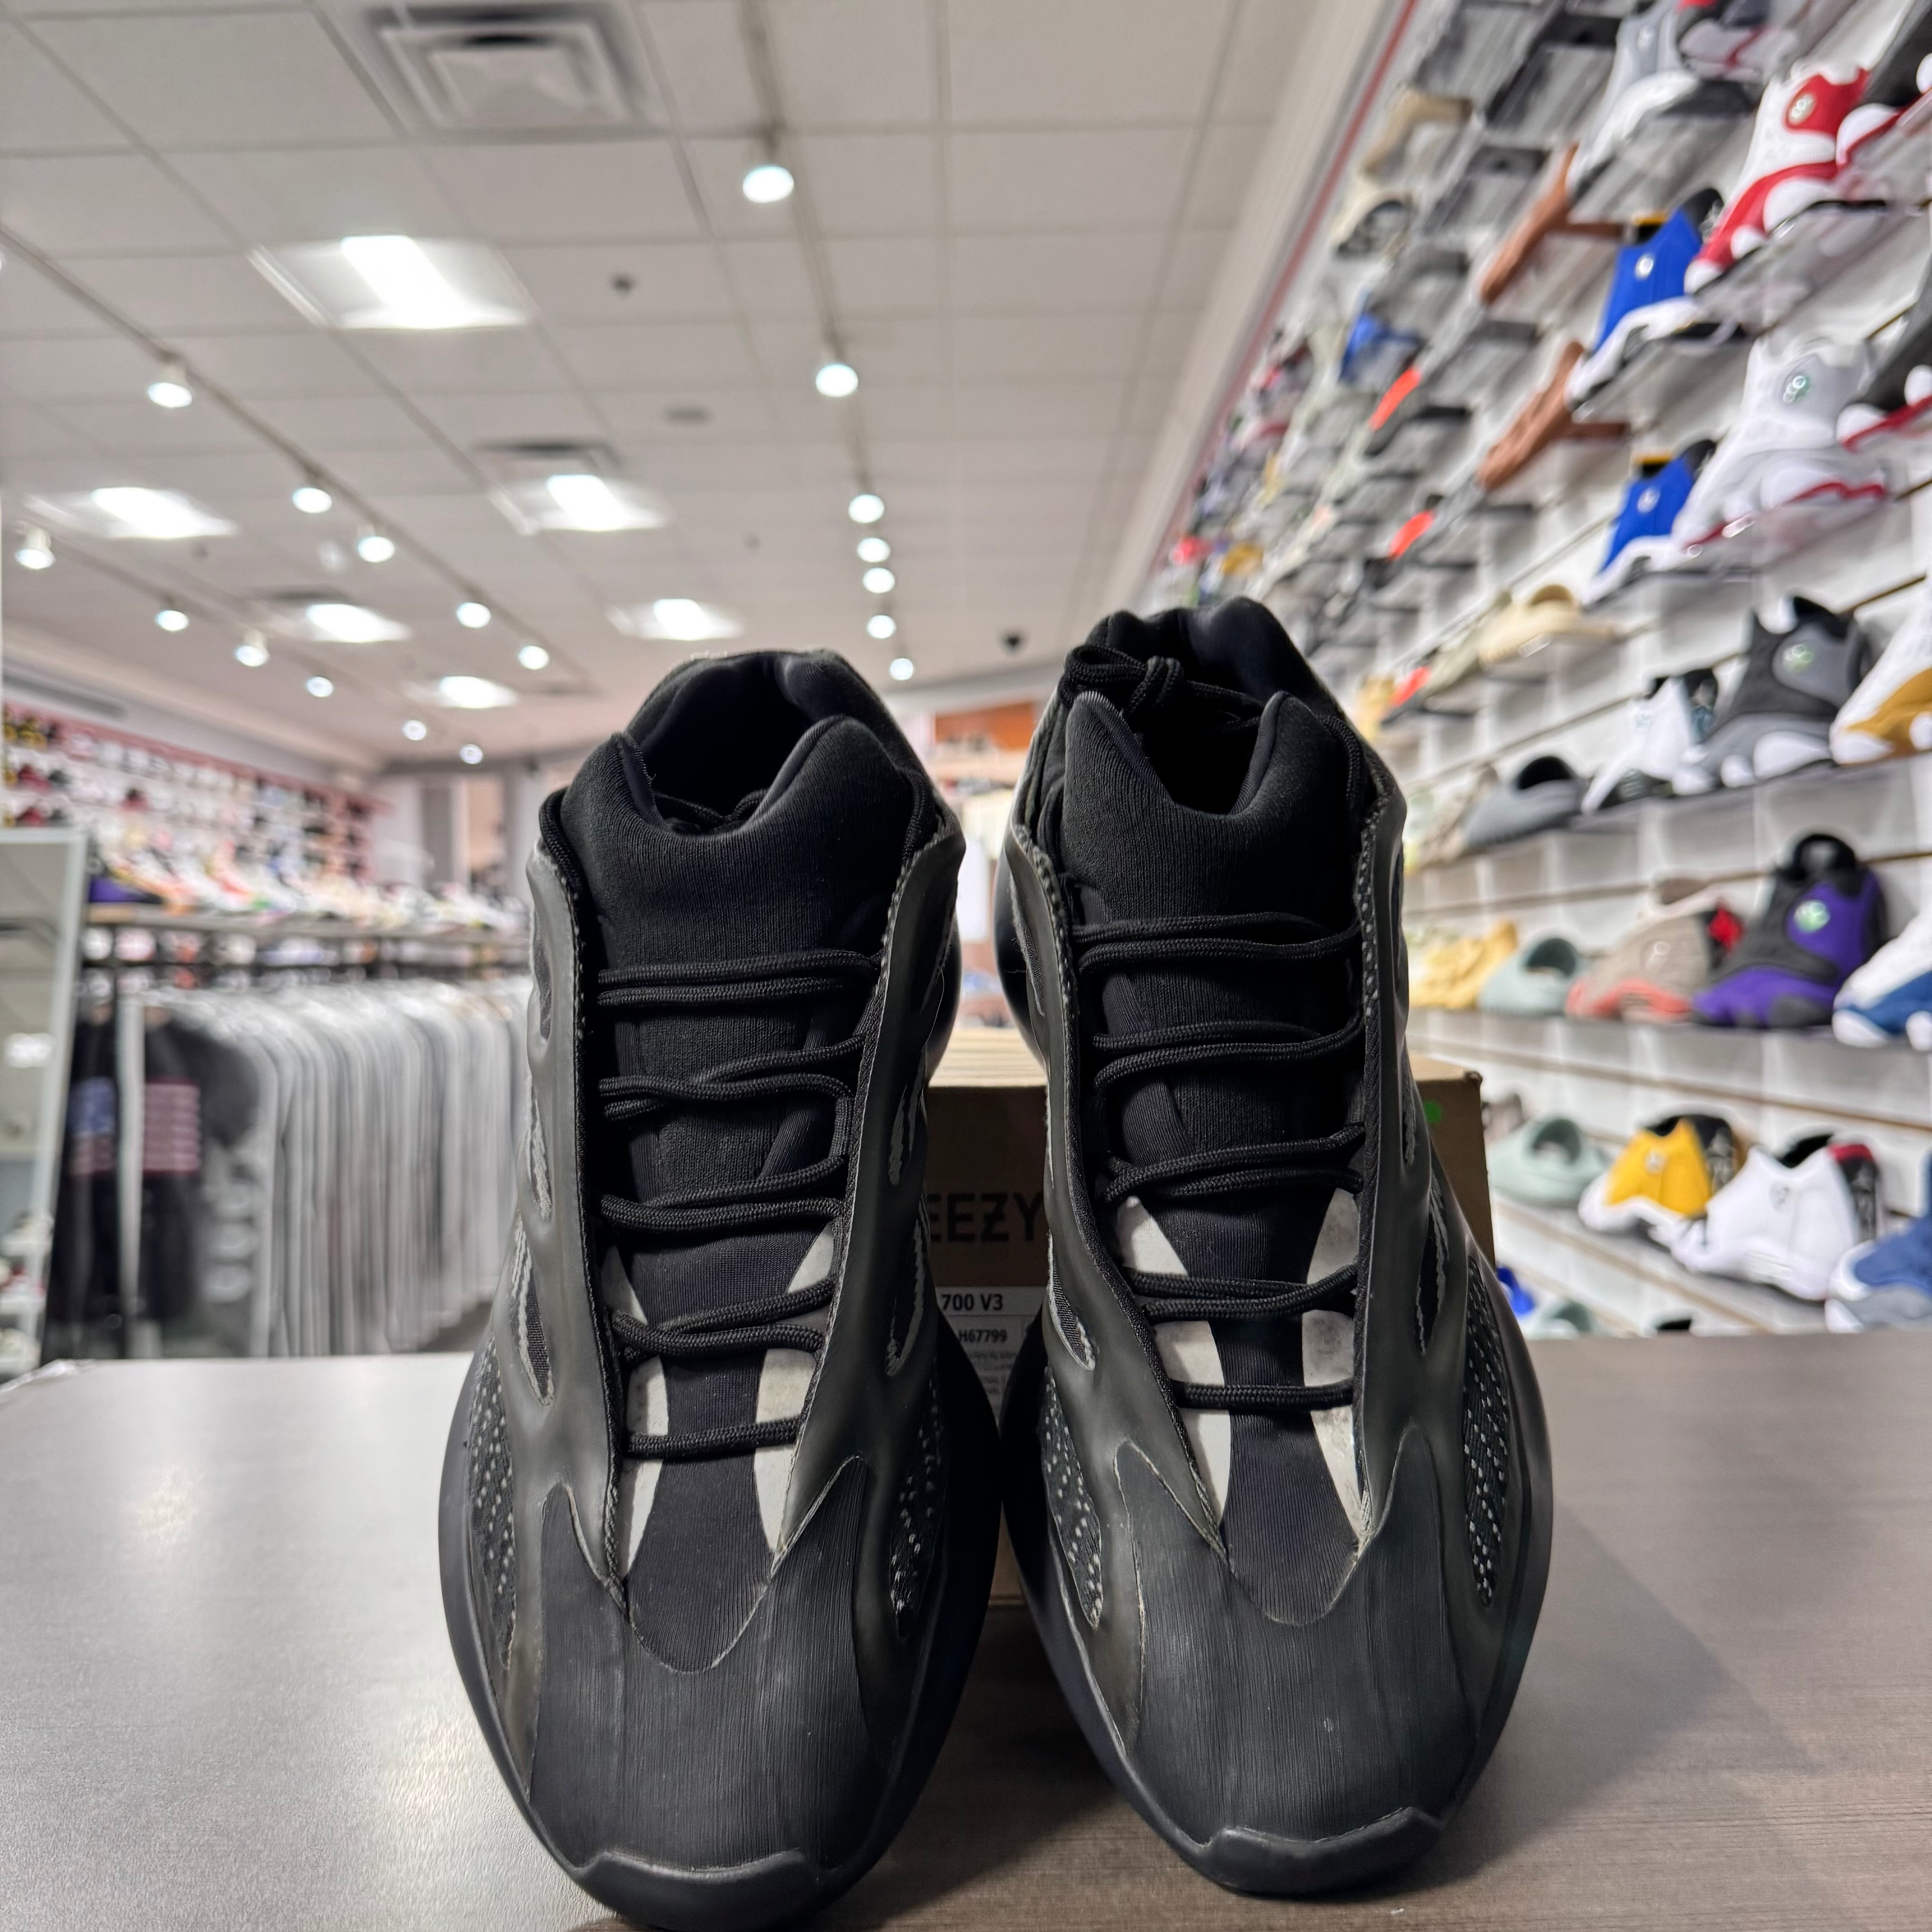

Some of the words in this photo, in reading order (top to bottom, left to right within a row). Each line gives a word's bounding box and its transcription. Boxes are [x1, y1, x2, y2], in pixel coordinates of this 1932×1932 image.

[942, 1294, 974, 1311] 700
[980, 1294, 1003, 1311] V3
[959, 1329, 1007, 1342] H67799
